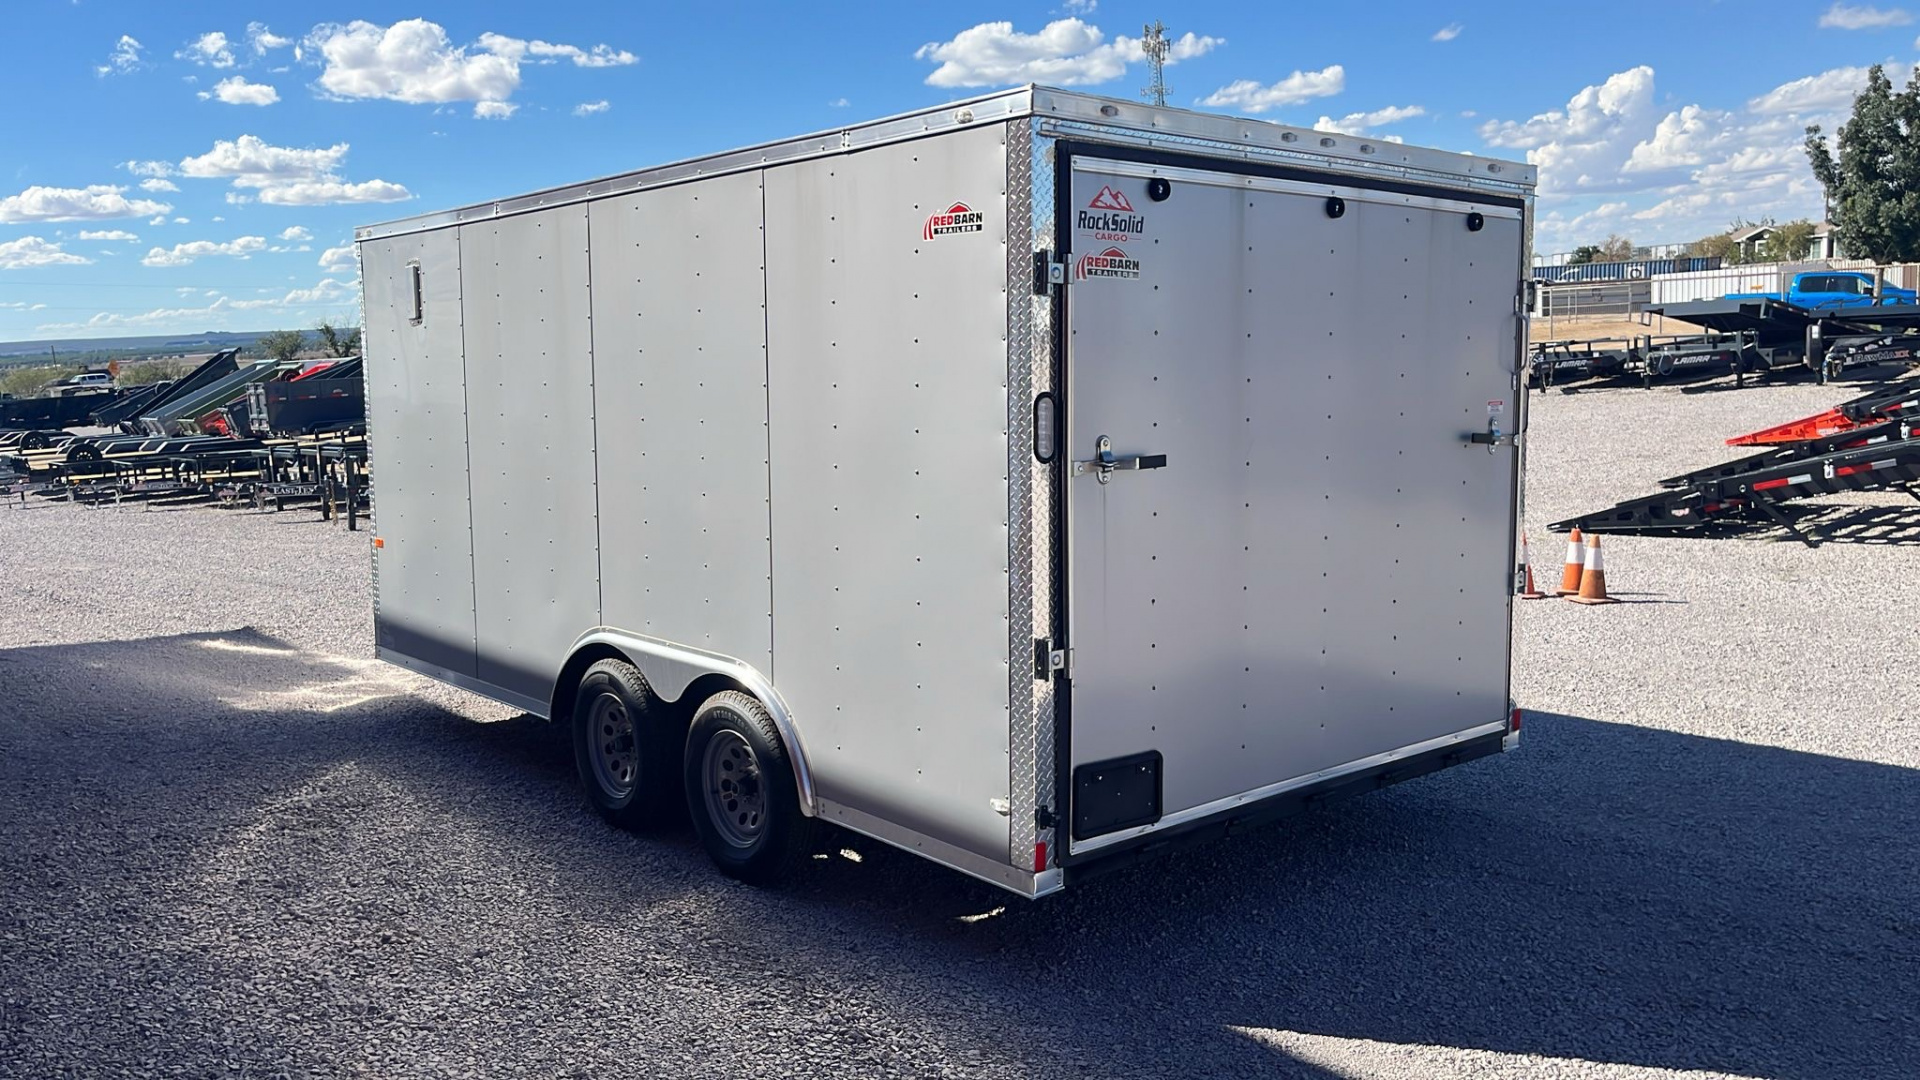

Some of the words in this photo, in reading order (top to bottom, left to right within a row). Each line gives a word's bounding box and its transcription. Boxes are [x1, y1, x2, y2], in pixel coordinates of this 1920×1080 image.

[933, 212, 982, 227] REDBARN
[1078, 210, 1145, 234] RockSolid
[936, 225, 978, 235] TRAILERS
[1095, 232, 1128, 242] CARGO
[1087, 256, 1140, 271] REDBARN
[1090, 269, 1135, 279] TRAILERS
[1554, 360, 1588, 369] LAMAR
[1673, 355, 1711, 365] LAMAR
